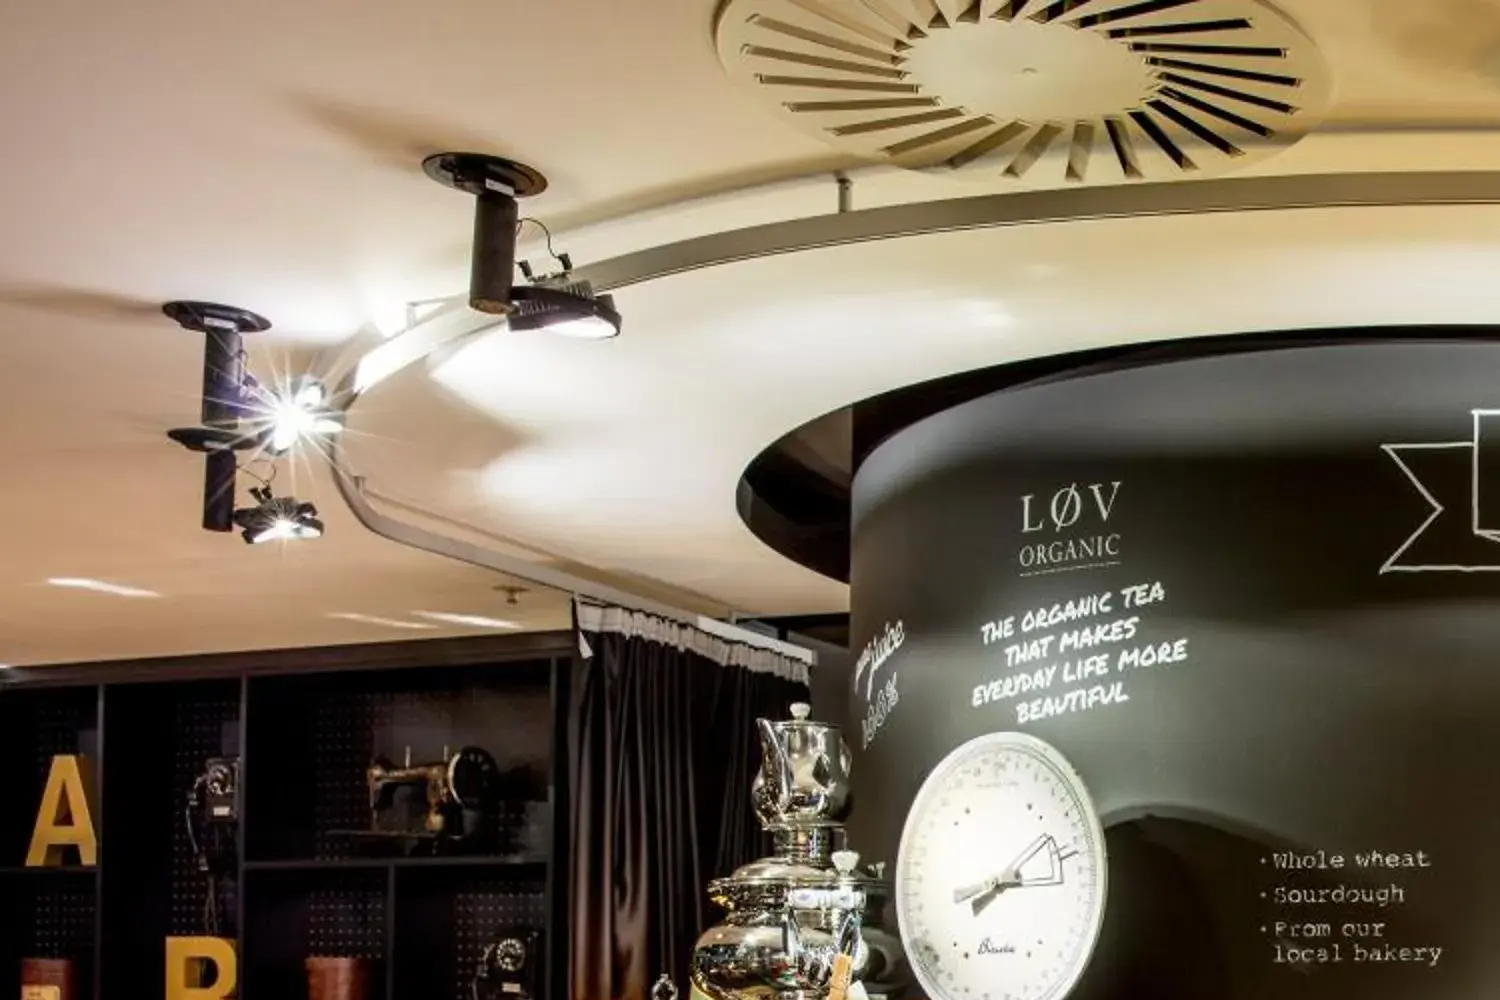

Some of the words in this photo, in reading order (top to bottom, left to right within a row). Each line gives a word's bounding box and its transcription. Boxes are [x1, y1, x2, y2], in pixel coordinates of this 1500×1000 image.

[1020, 481, 1122, 533] LØV
[1019, 534, 1121, 567] ORGANIC
[981, 616, 1015, 645] THE
[1021, 592, 1113, 632] ORGANIC
[1120, 581, 1165, 609] TEA
[1004, 635, 1055, 668] THAT
[1059, 616, 1140, 653] MAKES
[972, 665, 1056, 707] EVERYDAY
[1062, 654, 1110, 683] LIFE
[1118, 638, 1189, 672] MORE
[1016, 681, 1130, 724] BEAUTIFUL
[25, 755, 97, 866] A
[1272, 850, 1345, 869] Whole
[1355, 850, 1432, 869] wheat
[1274, 884, 1406, 907] Sourdough
[1342, 922, 1386, 937] our
[1273, 943, 1344, 963] local
[1353, 944, 1442, 967] bakery
